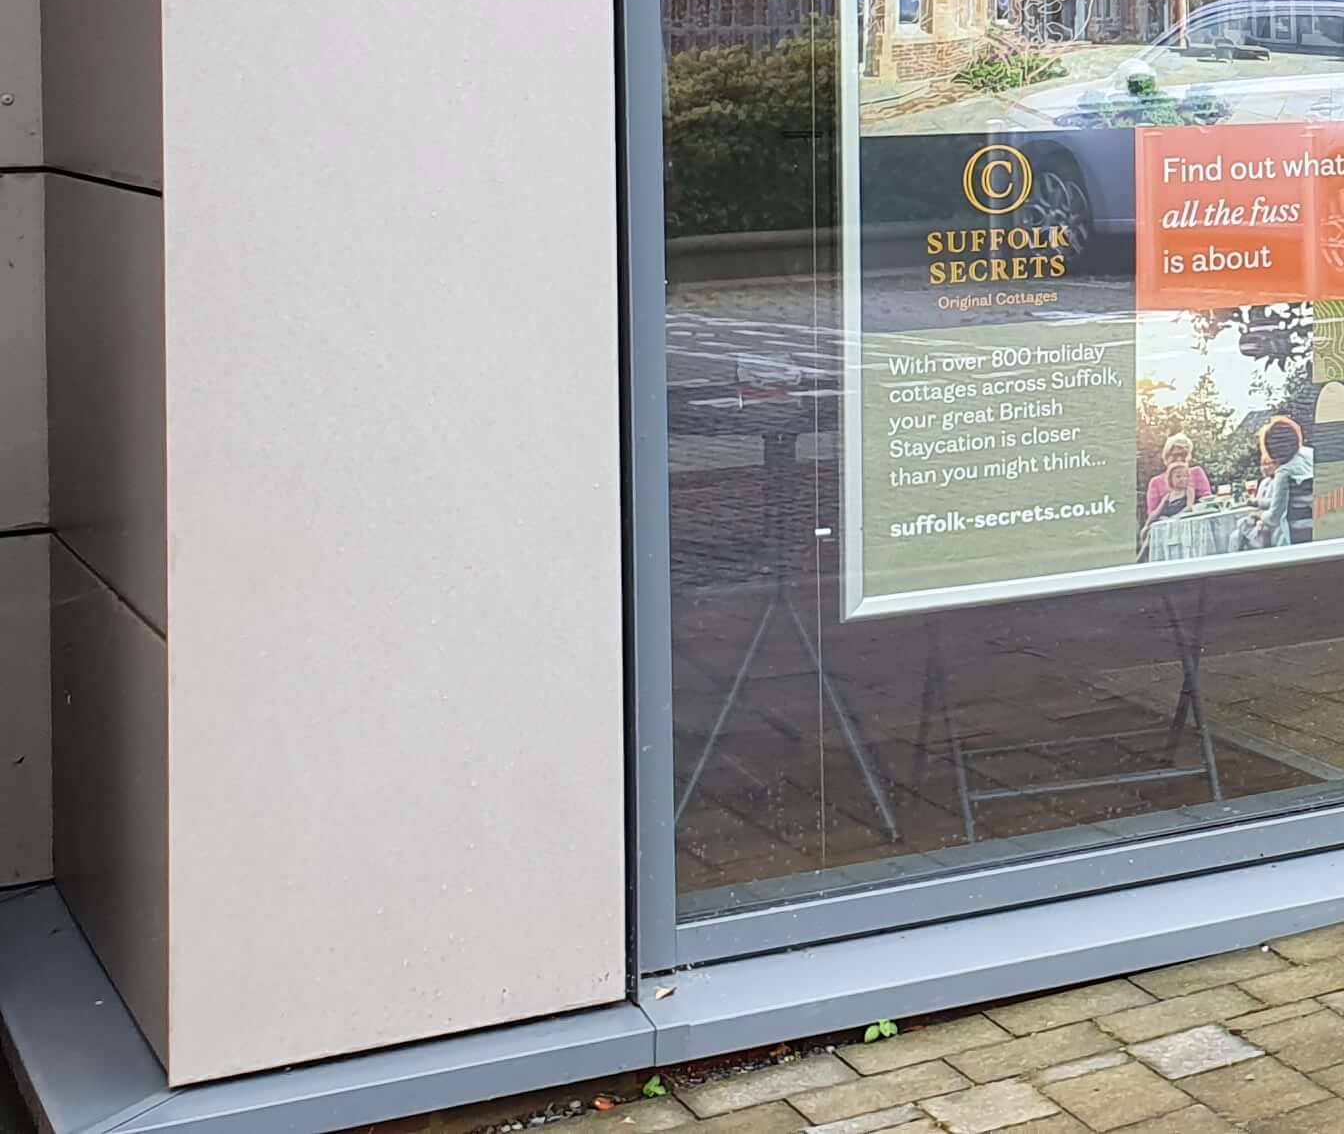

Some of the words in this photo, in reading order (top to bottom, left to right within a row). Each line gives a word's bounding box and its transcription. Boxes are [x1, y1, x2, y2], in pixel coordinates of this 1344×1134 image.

[1163, 154, 1222, 183] Find
[1230, 160, 1276, 180] out
[1162, 200, 1200, 229] all
[1203, 197, 1245, 227] the
[1249, 196, 1301, 227] fuss
[927, 225, 1070, 255] SUFFOLK
[929, 254, 1067, 284] SECRETS
[1163, 249, 1185, 274] is
[1192, 245, 1272, 273] about
[938, 293, 992, 312] Original
[996, 290, 1058, 308] Cottages
[889, 354, 937, 376] With
[942, 355, 986, 372] over
[992, 347, 1032, 368] 800
[1037, 343, 1105, 364] holiday
[889, 382, 977, 404] cottages
[982, 377, 1047, 396] across
[1051, 366, 1123, 389] Suffolk,
[888, 413, 937, 436] your
[942, 405, 995, 430] great
[999, 398, 1064, 421] British
[889, 433, 996, 460] Staycation
[1001, 430, 1017, 447] is
[1021, 425, 1081, 446] closer
[889, 467, 937, 487] than
[940, 465, 978, 487] you
[983, 456, 1039, 479] might
[1043, 449, 1107, 471] think...
[890, 494, 1117, 538] suffolk-secrets.co.uk
